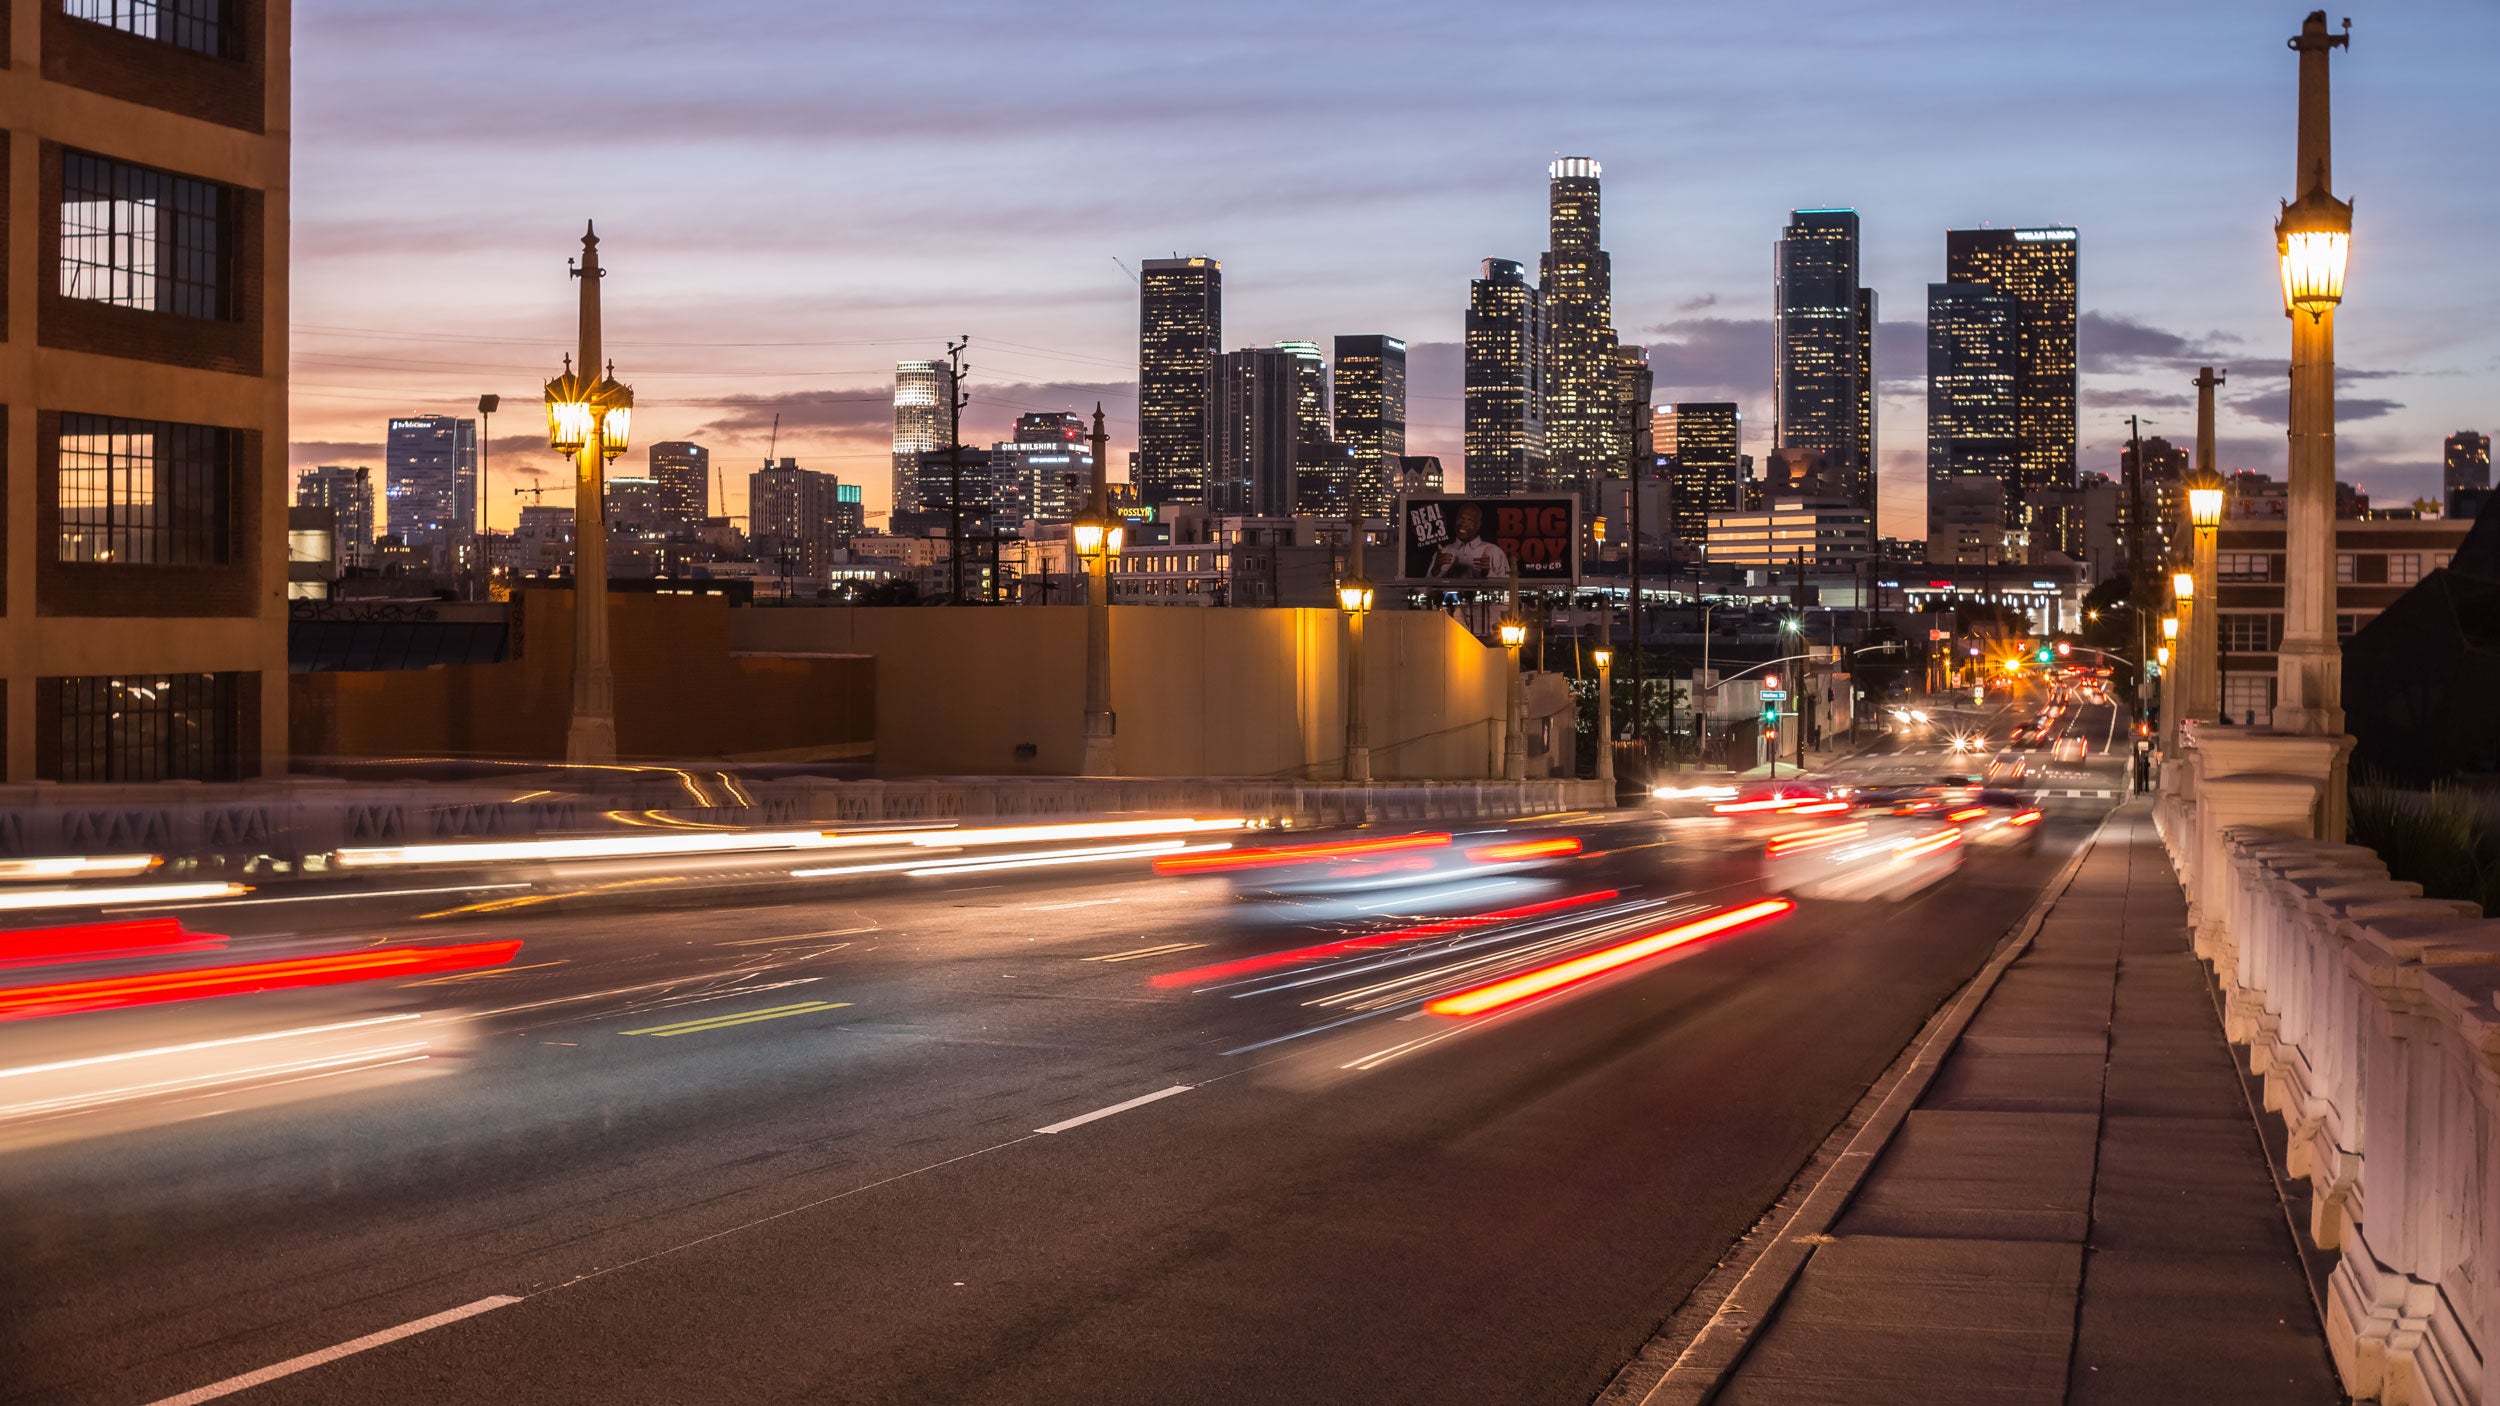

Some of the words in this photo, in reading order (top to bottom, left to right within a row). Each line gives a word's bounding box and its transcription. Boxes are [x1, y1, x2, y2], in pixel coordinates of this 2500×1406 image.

[1410, 503, 1443, 526] REAL
[1496, 507, 1567, 537] BIG
[1416, 519, 1447, 542] 92.3
[1496, 538, 1567, 562] BOY
[1525, 562, 1562, 570] MOVED
